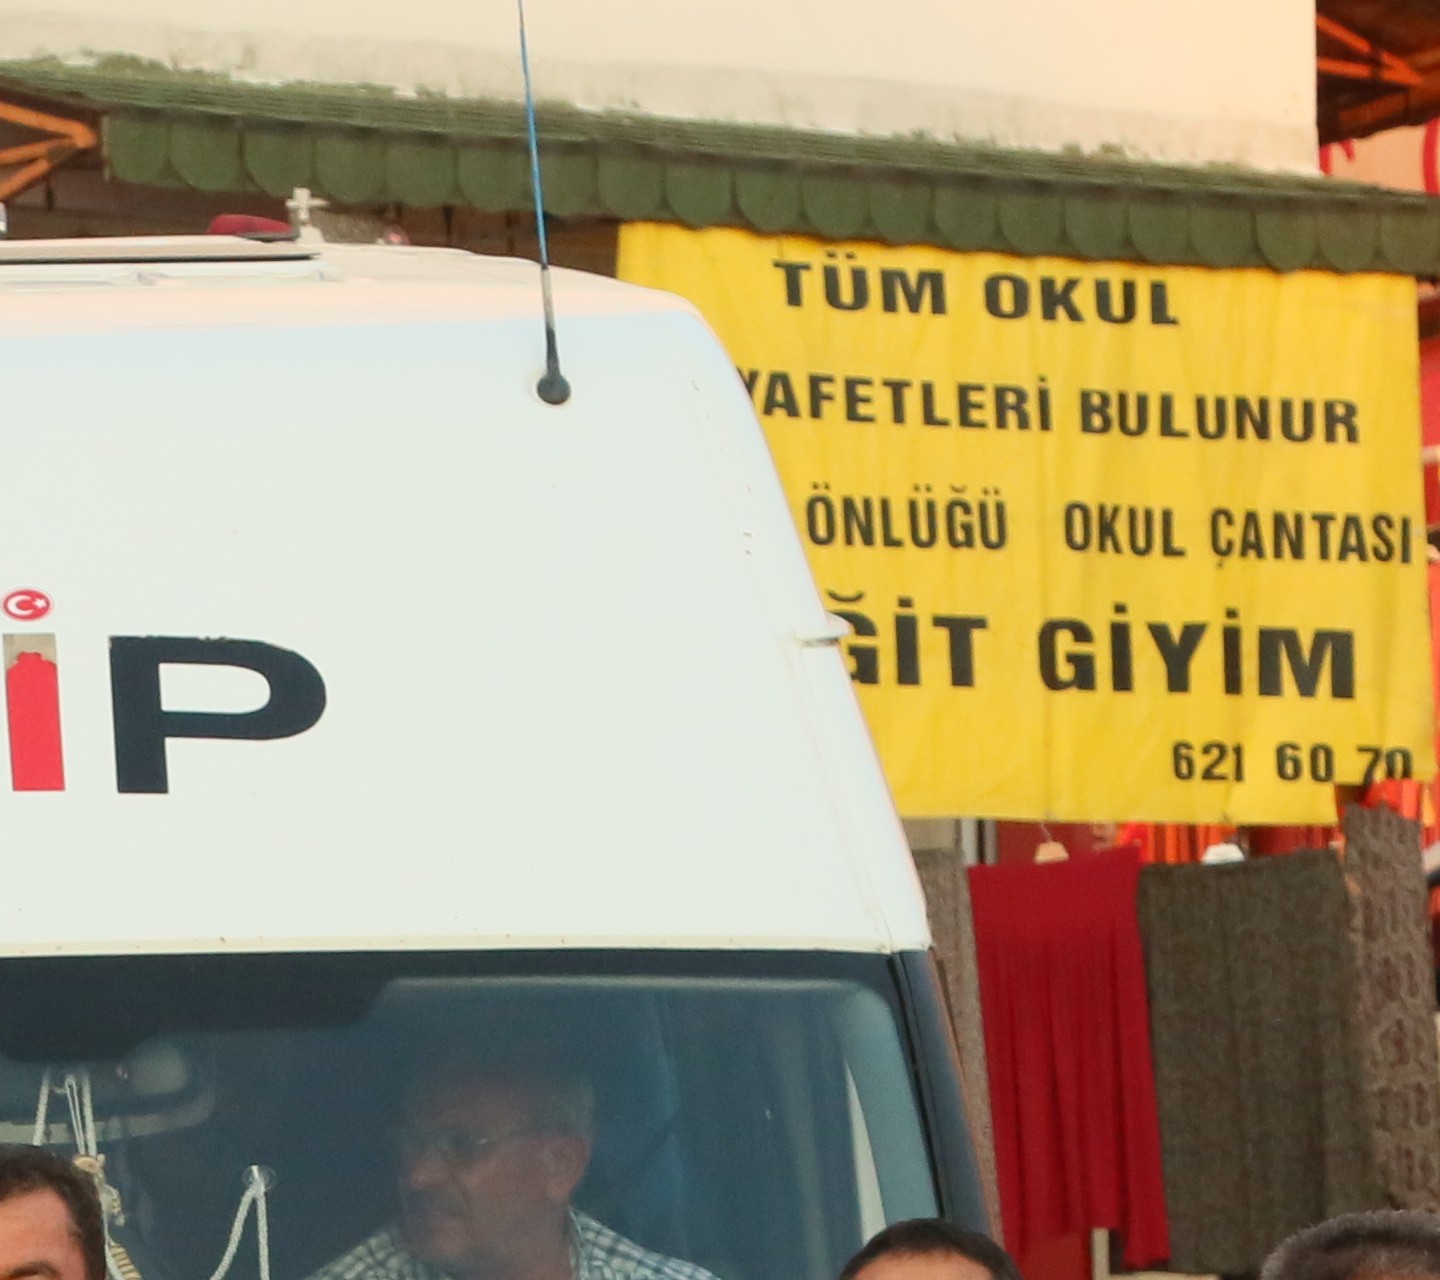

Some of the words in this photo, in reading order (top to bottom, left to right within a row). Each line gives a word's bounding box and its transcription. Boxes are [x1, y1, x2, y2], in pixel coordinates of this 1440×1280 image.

[773, 251, 949, 316] TÜM
[985, 273, 1181, 327] OKUL
[1079, 389, 1360, 444] BULUNUR
[806, 482, 1009, 551] ÖNLÜĞÜ
[1064, 501, 1187, 558] OKUL
[1209, 506, 1412, 569] ÇANTASI
[1038, 604, 1356, 700] GİYİM
[1171, 740, 1244, 783] 621
[1274, 740, 1334, 783] 60
